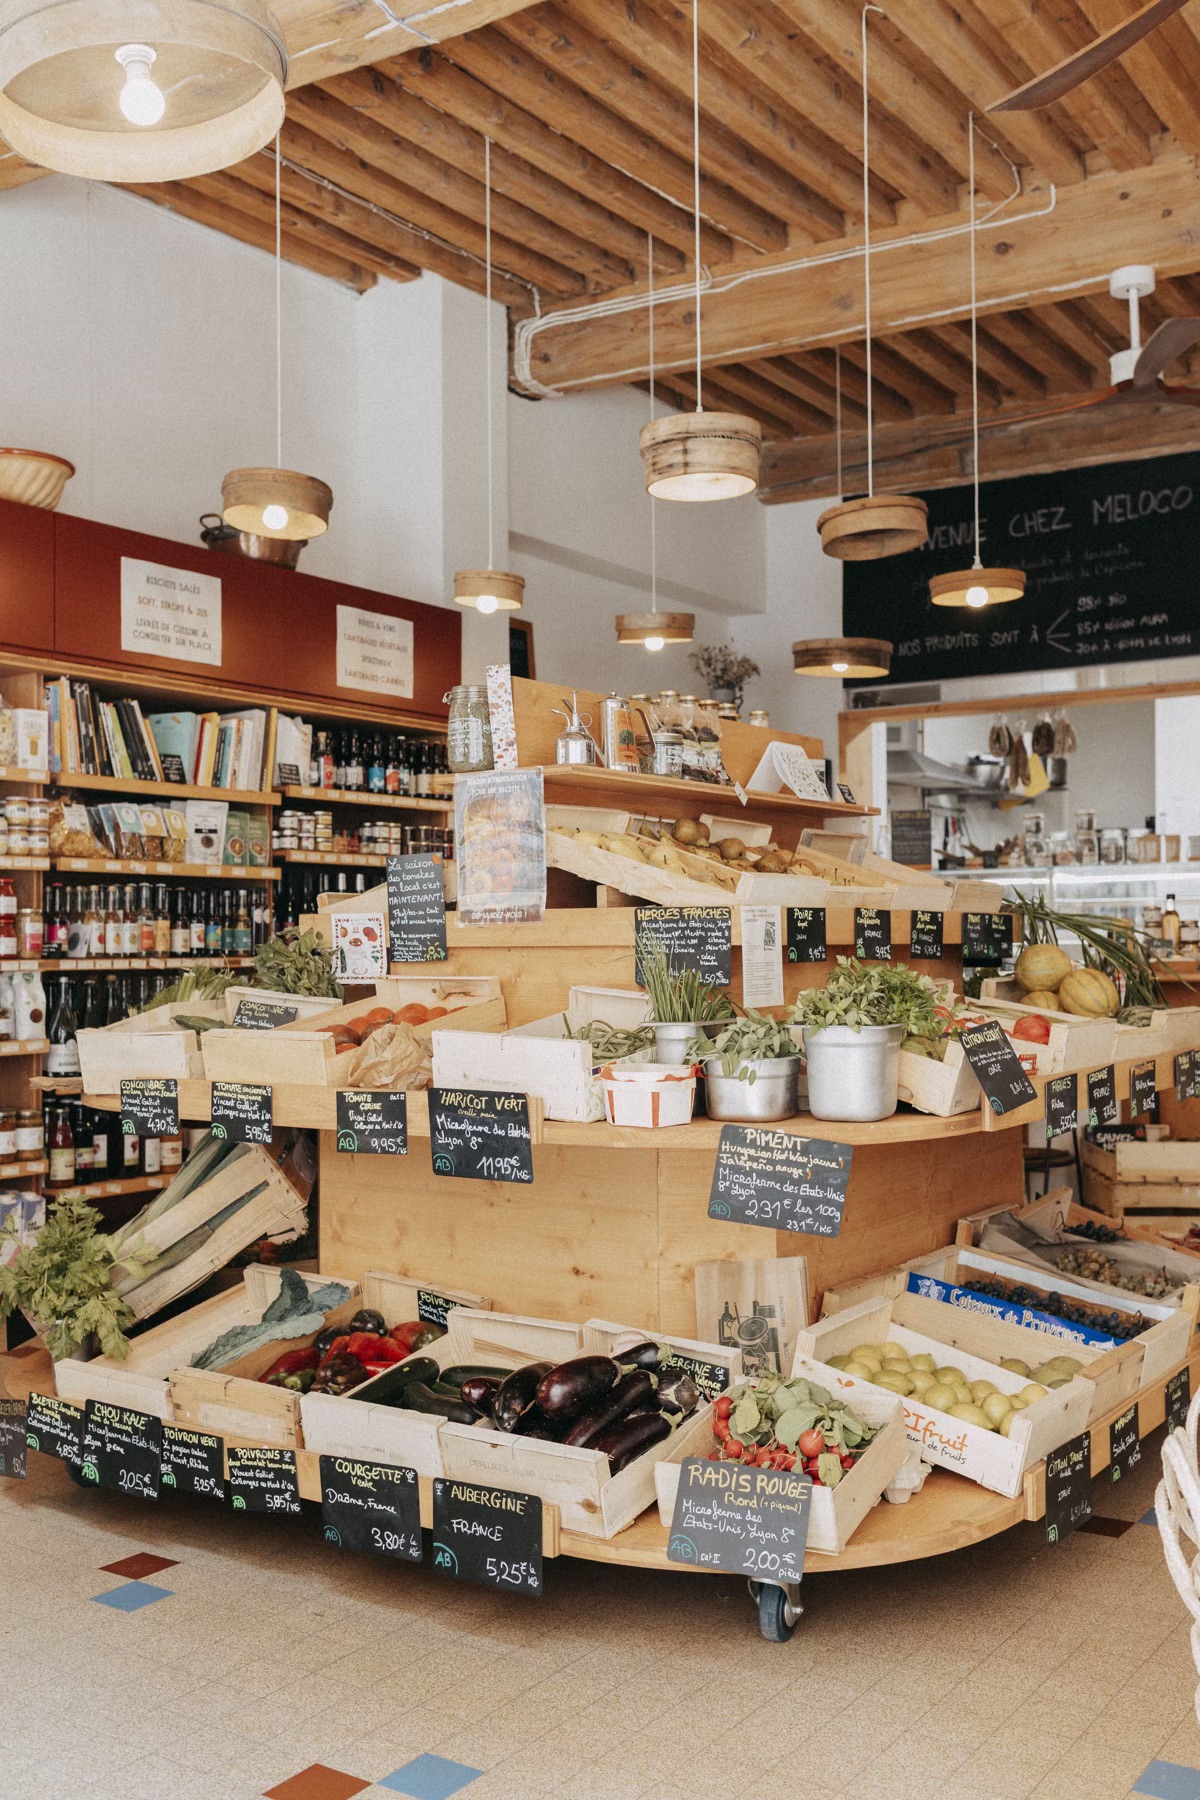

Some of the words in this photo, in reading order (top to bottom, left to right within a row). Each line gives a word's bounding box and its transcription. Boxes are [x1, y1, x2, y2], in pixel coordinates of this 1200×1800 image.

[1009, 506, 1072, 538] CHEZ
[1091, 485, 1193, 526] MELOCO
[135, 617, 160, 630] LIVRES
[161, 622, 170, 632] DE
[132, 629, 172, 644] CONSULTER
[175, 636, 186, 647] SUR
[188, 640, 212, 652] PLACE
[990, 630, 1020, 648] SONT
[1030, 623, 1040, 642] À
[471, 787, 488, 796] POUR
[488, 787, 497, 795] UNE
[498, 785, 521, 794] RECETTE
[388, 857, 402, 872] La
[404, 860, 434, 870] saison
[388, 874, 401, 883] des
[402, 869, 435, 881] tomates
[388, 885, 398, 893] en
[399, 881, 421, 893] local
[636, 907, 681, 921] HERBES
[864, 930, 883, 939] FRANCE
[215, 1082, 242, 1093] TOMATE
[121, 1095, 141, 1105] Vincent
[212, 1096, 236, 1107] Vincent
[343, 1092, 373, 1103] TOMATE
[494, 1096, 527, 1112] VERT
[479, 1111, 498, 1119] main
[122, 1122, 133, 1134] AB
[211, 1126, 225, 1139] AB
[435, 1113, 492, 1138] Microferme
[492, 1123, 506, 1137] des
[338, 1137, 356, 1151] AB
[435, 1130, 464, 1151] Lyon
[720, 1141, 772, 1161] Hungarian
[772, 1149, 790, 1161] Hot
[788, 1151, 809, 1163] Wax
[807, 1154, 840, 1170] jaune
[435, 1159, 451, 1172] AB
[476, 1155, 521, 1179] 11,95€
[511, 1167, 530, 1181] /KG
[775, 1164, 805, 1179] rouge
[718, 1166, 782, 1191] Microferme
[782, 1180, 799, 1194] des
[799, 1183, 845, 1203] Etats-Unis
[718, 1180, 730, 1192] 8e
[730, 1182, 756, 1200] Lyon
[709, 1203, 727, 1215] AB
[793, 1199, 813, 1215] les
[814, 1204, 841, 1223] 100g
[949, 1288, 1004, 1321] Coteaux
[1004, 1309, 1019, 1326] de
[1020, 1309, 1086, 1345] Provence
[31, 1393, 60, 1411] BLETTE
[30, 1409, 52, 1424] Vincent
[94, 1403, 121, 1422] CHOU
[122, 1411, 148, 1431] KALE
[1114, 1405, 1136, 1435] MANGUE
[87, 1423, 122, 1443] Microferme
[111, 1419, 134, 1435] Toscane
[199, 1435, 218, 1449] VERT
[927, 1440, 939, 1452] de
[940, 1445, 967, 1465] fruits
[189, 1457, 210, 1472] Rhône
[335, 1459, 404, 1484] COURGETTE
[81, 1465, 96, 1480] AB
[161, 1474, 174, 1485] AB
[231, 1467, 256, 1479] Vincent
[142, 1486, 158, 1498] pièce
[756, 1474, 814, 1500] ROUGE
[232, 1498, 245, 1509] AB
[367, 1498, 397, 1515] France
[724, 1491, 758, 1510] Rond
[682, 1498, 743, 1521] Microferme
[745, 1509, 763, 1523] des
[325, 1529, 338, 1541] AB
[451, 1518, 504, 1542] FRANCE
[747, 1523, 779, 1545] Lyon
[1048, 1529, 1056, 1543] AB
[408, 1546, 421, 1557] KG
[671, 1539, 693, 1559] AB
[434, 1550, 452, 1568] AB
[778, 1567, 801, 1581] pièce
